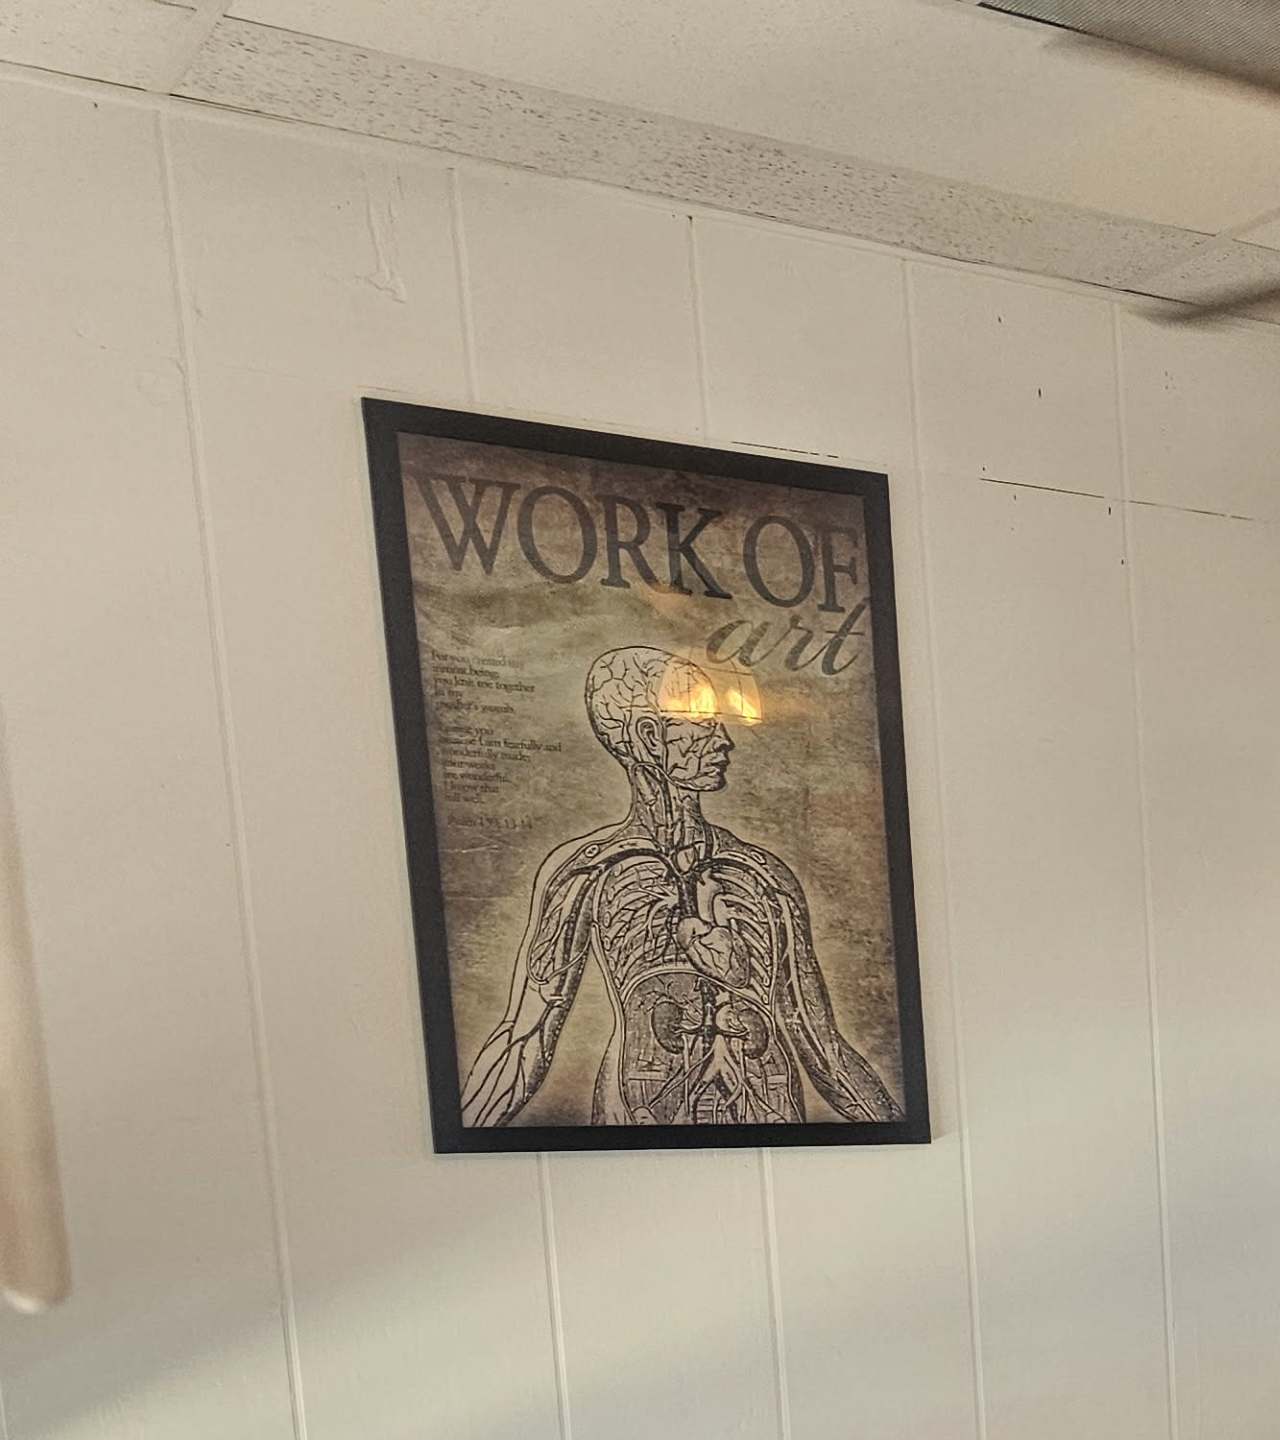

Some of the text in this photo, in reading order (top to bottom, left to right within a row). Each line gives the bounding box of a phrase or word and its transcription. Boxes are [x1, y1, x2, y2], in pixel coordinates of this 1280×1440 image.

[403, 474, 861, 613] WORK OF
[704, 602, 869, 676] art
